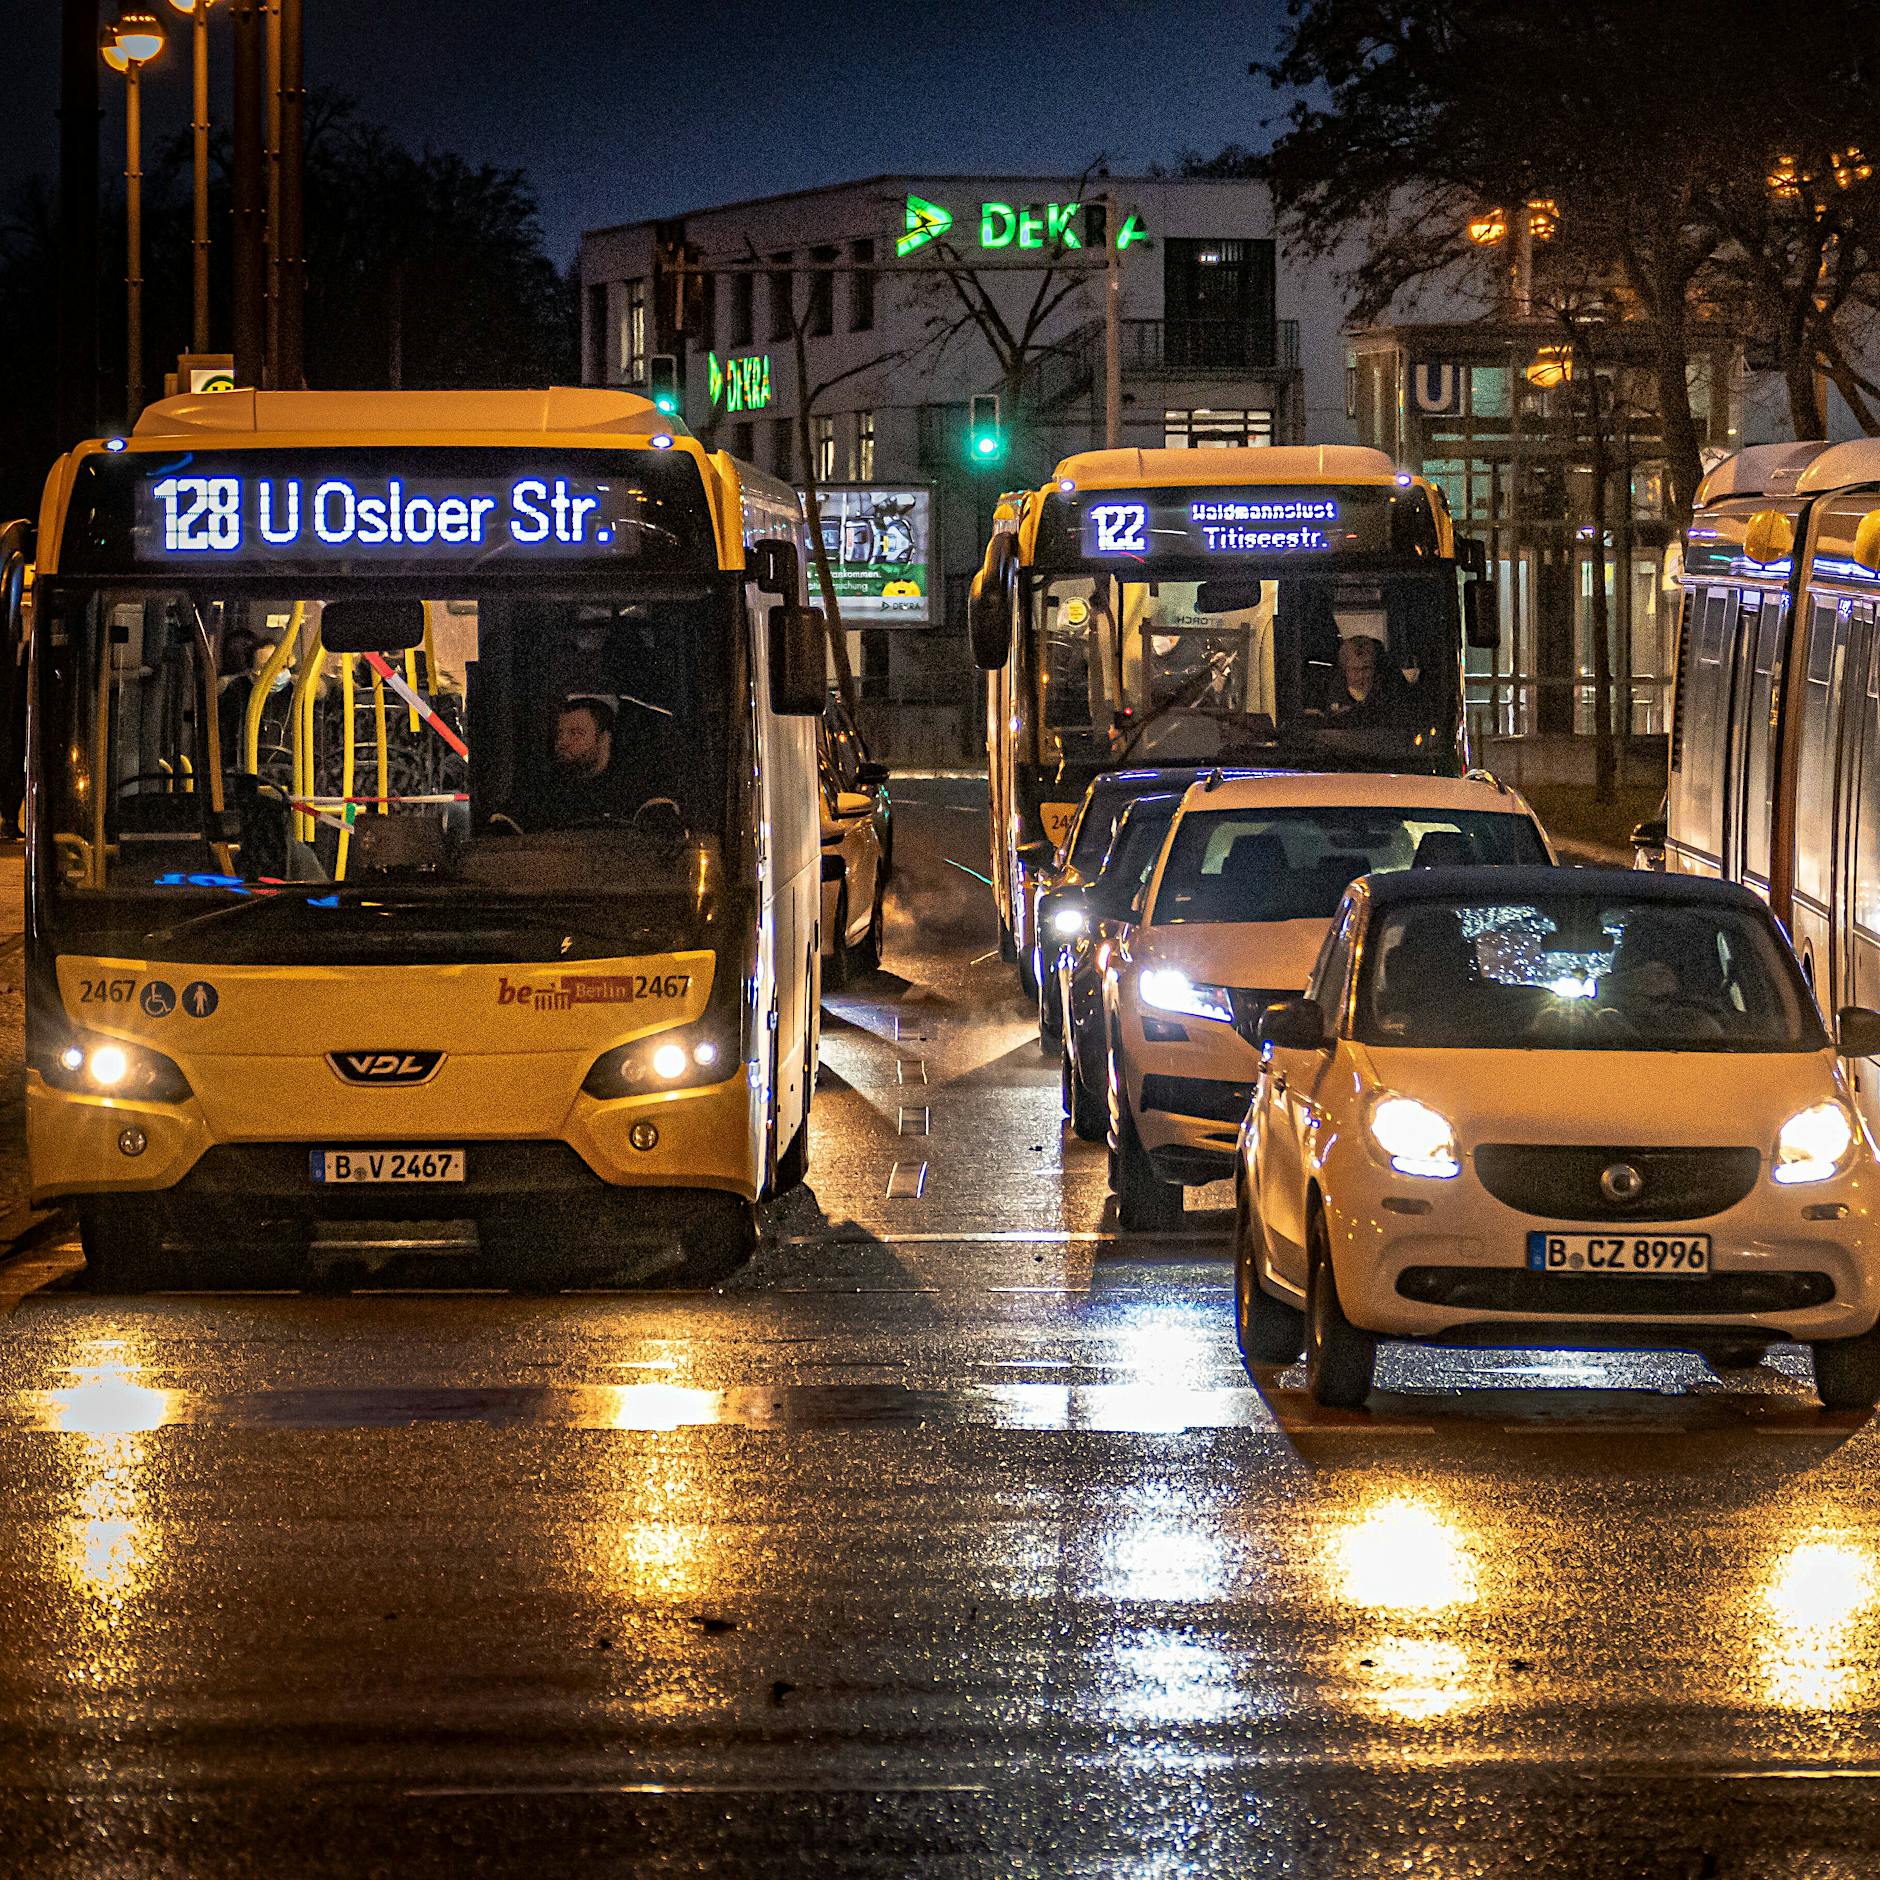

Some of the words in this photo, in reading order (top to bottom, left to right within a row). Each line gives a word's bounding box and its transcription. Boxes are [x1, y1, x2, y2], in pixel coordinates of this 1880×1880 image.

[980, 202, 1148, 250] DEKA
[1415, 363, 1453, 411] U
[153, 478, 241, 551] 128
[260, 481, 299, 542] U
[314, 480, 495, 542] Osloer
[511, 480, 610, 542] Str.
[1090, 505, 1146, 551] 122
[1203, 526, 1328, 549] Titiseestr.
[80, 979, 136, 1003] 2467
[576, 983, 626, 999] Berlin
[634, 975, 691, 999] 2467
[347, 1055, 424, 1075] VDL
[335, 1155, 351, 1179] B
[369, 1155, 384, 1178] V
[390, 1154, 452, 1179] 2467
[1549, 1239, 1567, 1267] B
[1587, 1239, 1625, 1268] CZ
[1633, 1240, 1705, 1269] 8996
